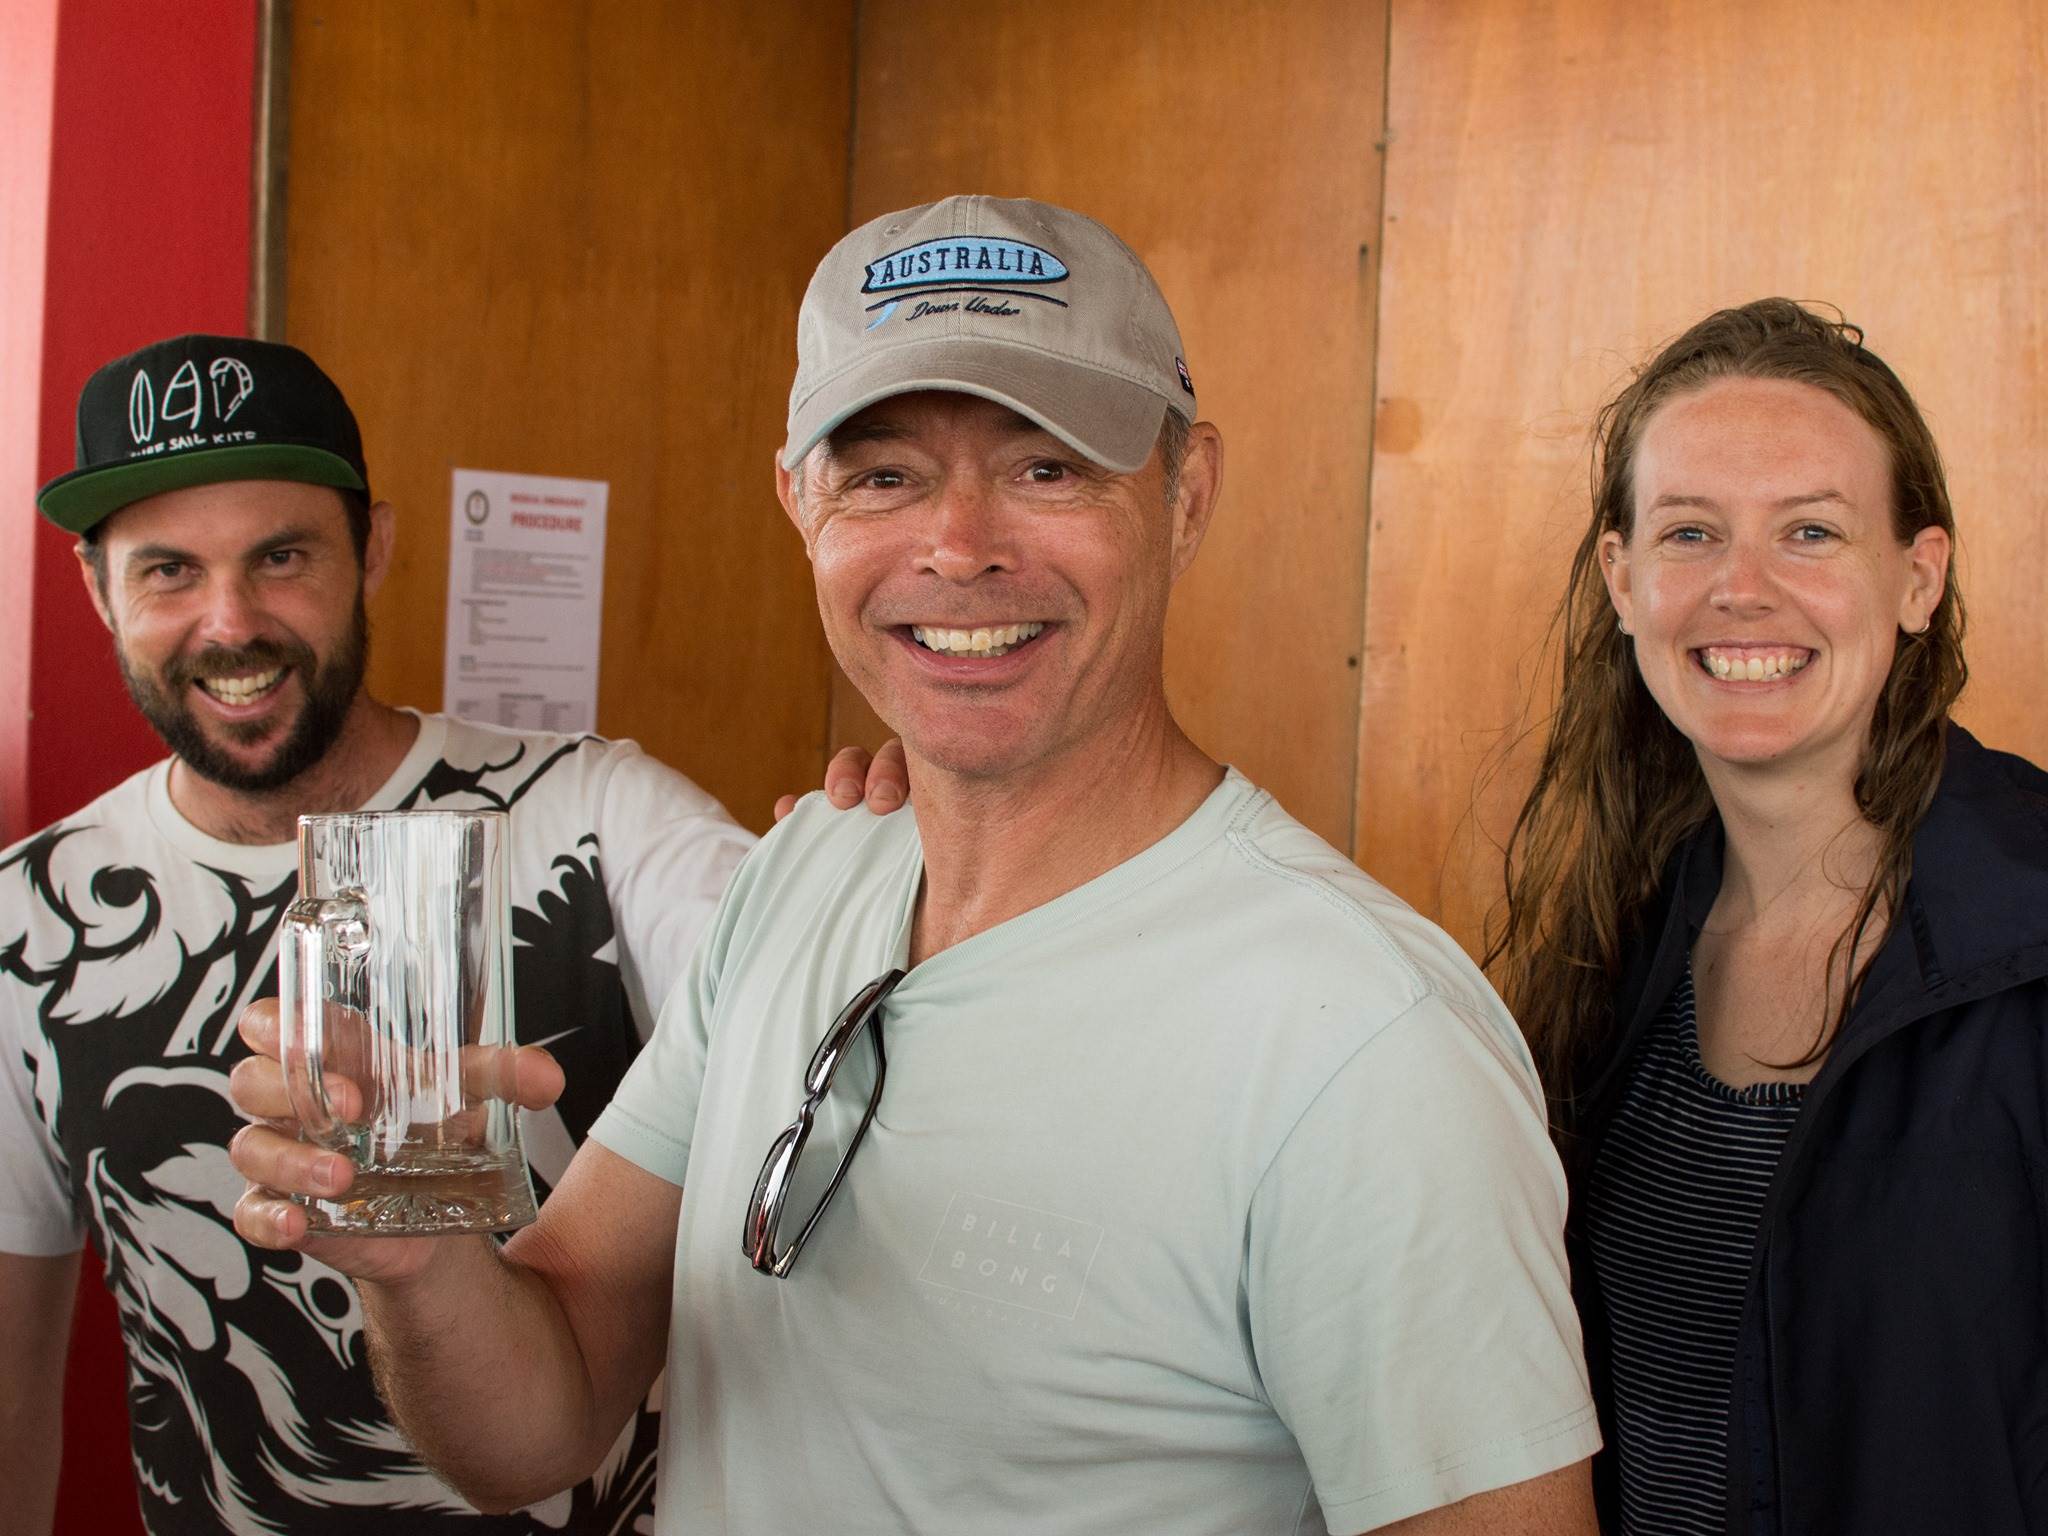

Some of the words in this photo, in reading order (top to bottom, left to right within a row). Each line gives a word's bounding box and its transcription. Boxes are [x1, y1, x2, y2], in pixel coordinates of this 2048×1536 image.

[880, 246, 1046, 284] AUSTRALIA
[905, 301, 959, 321] Down
[964, 296, 1021, 316] Under
[168, 433, 207, 450] SAIL
[511, 513, 583, 532] PROCEDURE
[951, 1250, 1057, 1293] BONG
